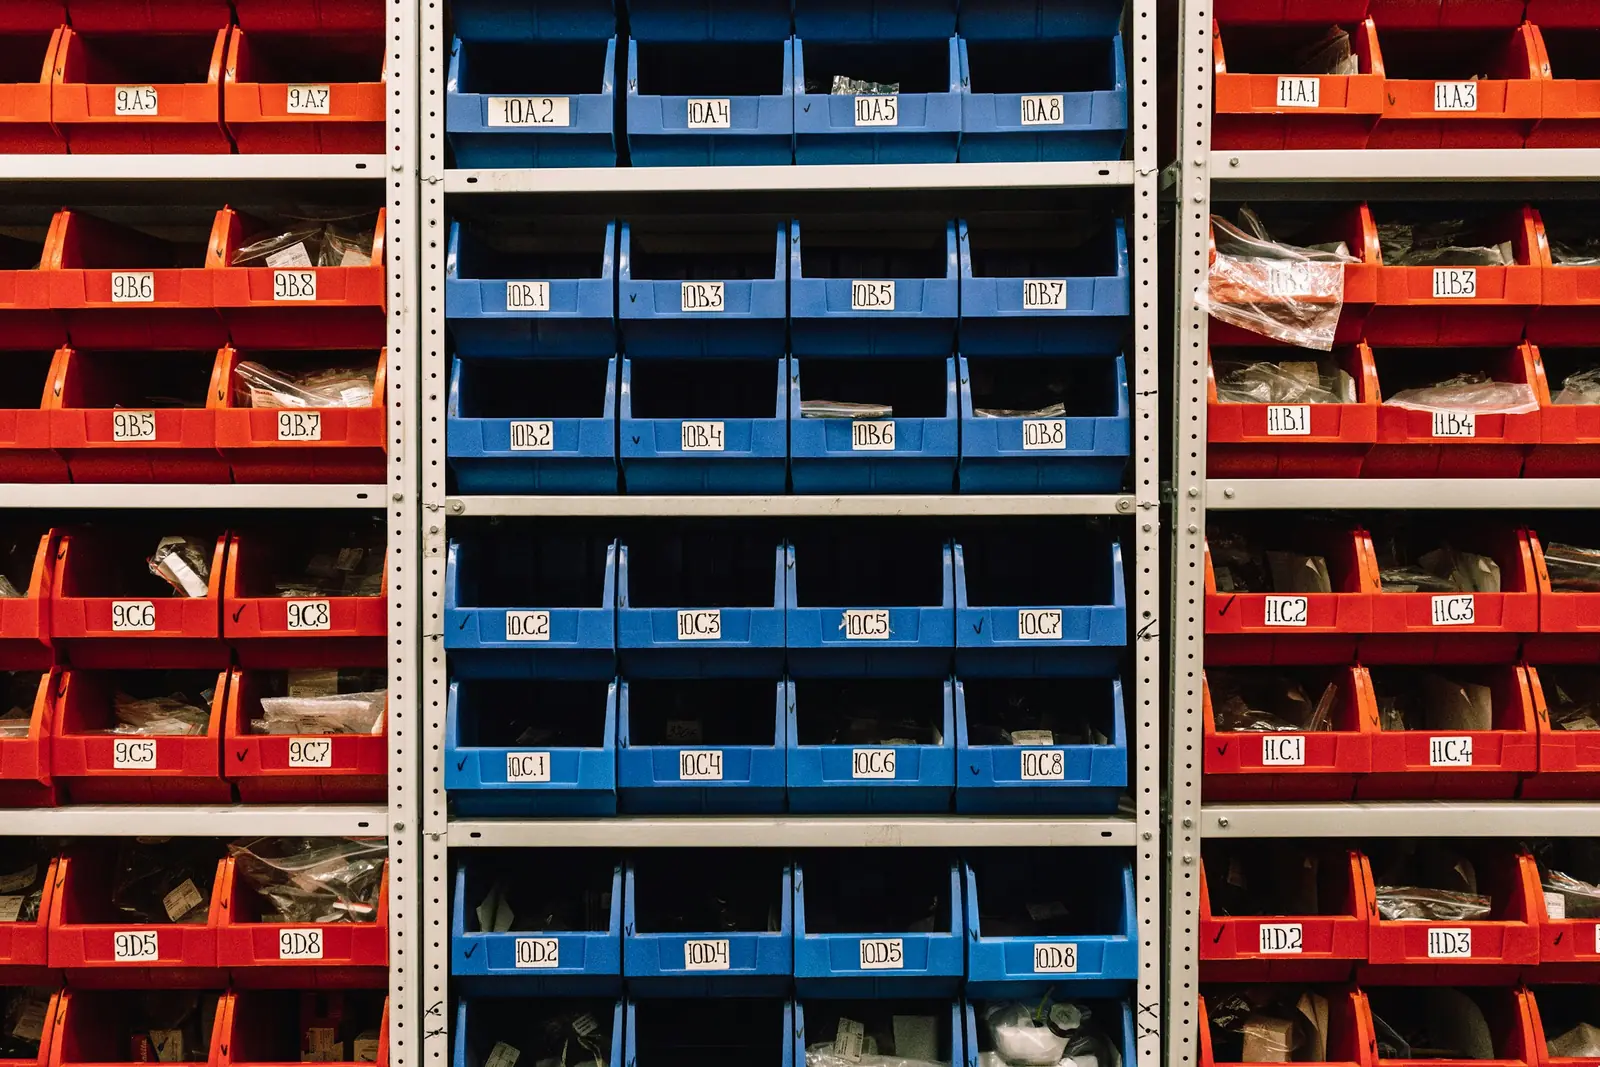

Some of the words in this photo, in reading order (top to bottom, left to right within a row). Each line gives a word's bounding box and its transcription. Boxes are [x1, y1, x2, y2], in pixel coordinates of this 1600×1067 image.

[117, 90, 157, 110] 9.A.5
[289, 89, 329, 107] 9.A.7
[1280, 81, 1317, 102] 11.A.1
[1436, 85, 1475, 107] 11.A.3
[504, 99, 554, 122] 10.A.2
[688, 102, 728, 123] 10.A.4
[856, 99, 896, 121] 10.A.5
[1022, 99, 1061, 121] 10.A.8
[113, 276, 152, 297] 9.B.6
[275, 274, 314, 296] 9.B.8
[1435, 271, 1475, 294] 11.B.3
[508, 285, 544, 306] 10.B.1
[682, 285, 722, 308] 10.B.3
[852, 284, 892, 306] 10.B.5
[1024, 283, 1064, 305] 10.B.7
[114, 415, 154, 436] 9.B.5
[280, 414, 319, 436] 9.B.7
[1269, 408, 1306, 430] 11.B.1
[1434, 413, 1473, 435] 11.B.4
[511, 424, 550, 446] 10.B.2
[682, 425, 722, 447] 10.B.4
[853, 423, 893, 445] 10.B.6
[1024, 423, 1064, 445] 10.B.8
[113, 605, 155, 626] 9.C.6
[288, 604, 329, 627] 9.C.8
[1266, 599, 1307, 621] 11.C.2
[1434, 598, 1474, 621] 11.C.3
[507, 615, 548, 635] 10.C.2
[679, 613, 720, 635] 10.C.3
[847, 613, 888, 635] 10.C.5
[1019, 613, 1061, 634] 10.C.7
[115, 743, 154, 762] 9.C.5
[290, 742, 330, 762] 9.C.7
[1265, 739, 1301, 760] 11.C.1
[1432, 740, 1473, 762] 11.C.4
[508, 757, 544, 777] 10.C.1
[681, 753, 721, 775] 10.C.4
[854, 752, 895, 773] 10.C.6
[1022, 754, 1063, 776] 10.C.8
[116, 934, 157, 956] 9.D.5
[281, 932, 321, 954] 9.D.8
[1262, 928, 1303, 949] 11.D.2
[1429, 932, 1470, 953] 11.D.3
[517, 941, 558, 963] 10.D.2
[688, 942, 727, 964] 10.D.4
[861, 943, 902, 963] 10.D.5
[1035, 947, 1075, 968] 10.D.8
